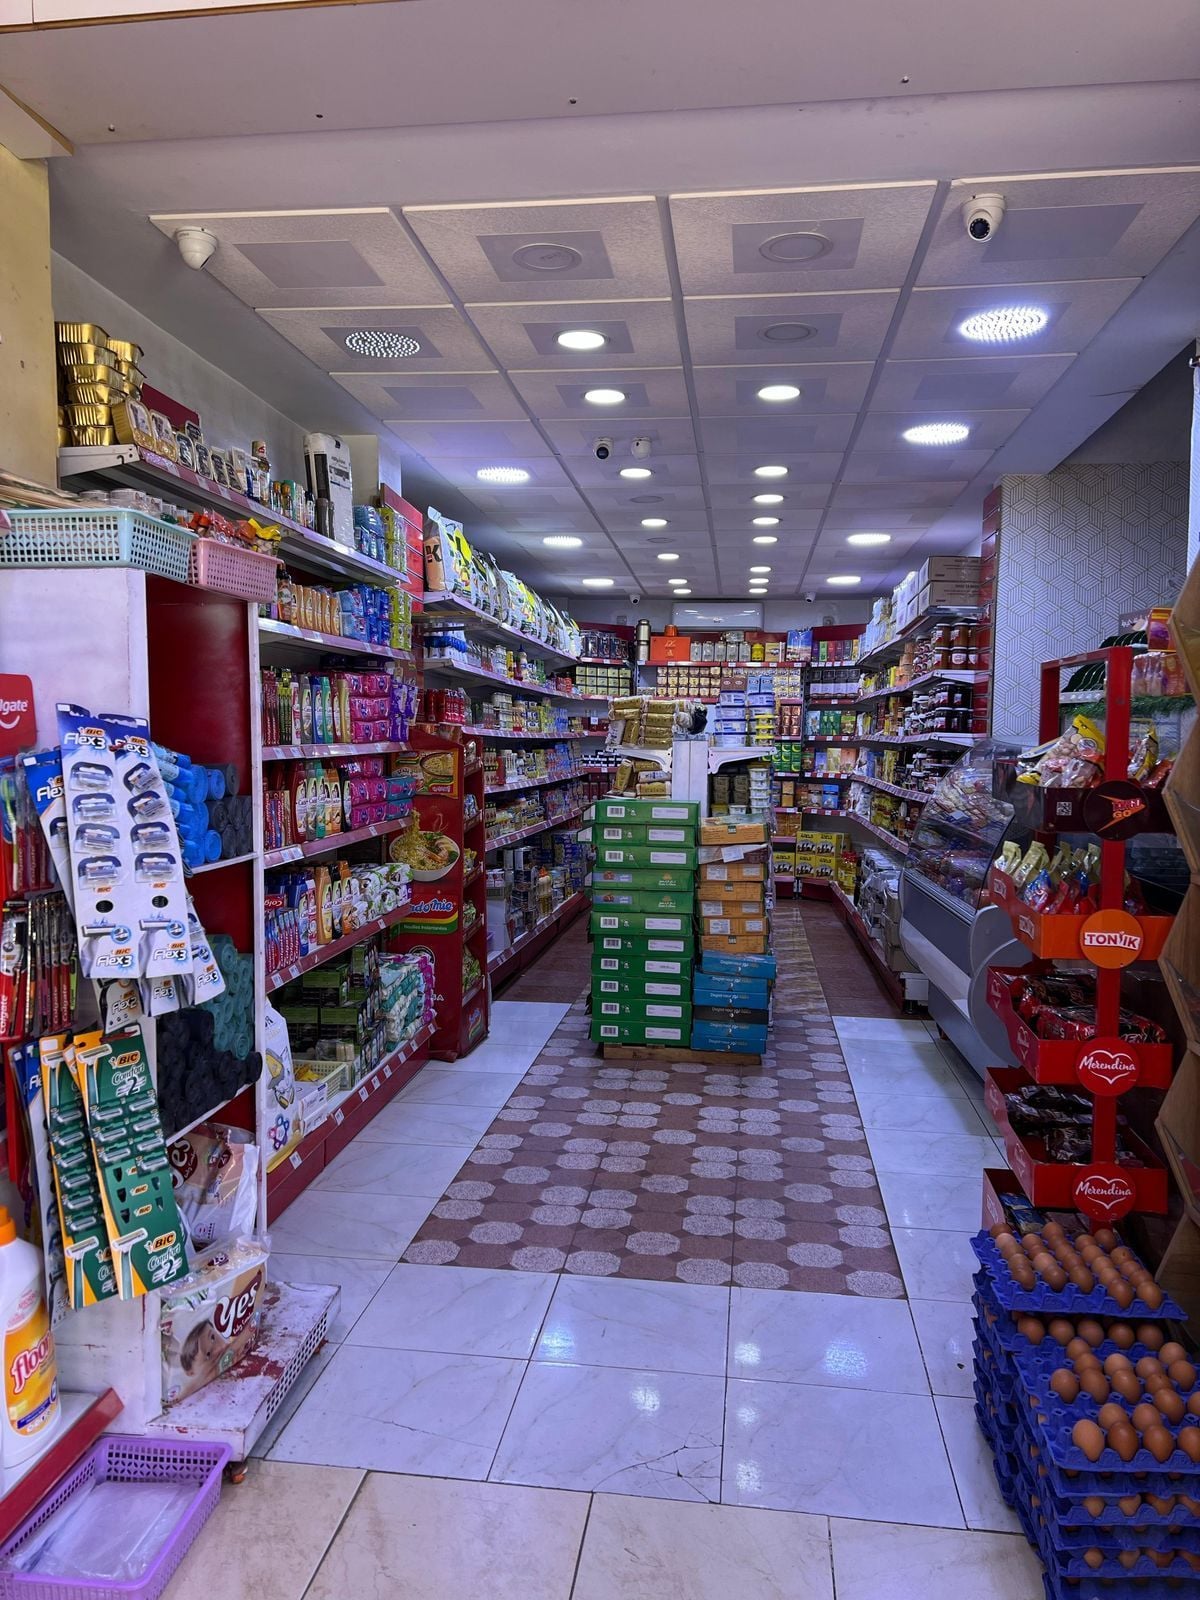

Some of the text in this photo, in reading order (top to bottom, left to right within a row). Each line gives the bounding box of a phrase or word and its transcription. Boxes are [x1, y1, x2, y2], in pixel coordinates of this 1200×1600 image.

[64, 733, 105, 749] Flex3
[37, 786, 63, 801] Flex
[265, 900, 283, 908] Colg
[1086, 933, 1138, 948] TONIK
[96, 955, 132, 968] Flex3
[154, 949, 187, 961] Flex3
[118, 1053, 138, 1065] BIC
[1079, 1055, 1136, 1071] Merendina
[112, 1063, 145, 1085] Comfort
[135, 1185, 147, 1194] BIC
[1075, 1180, 1132, 1196] Merendina
[154, 1234, 174, 1249] BIC
[147, 1243, 181, 1271] Comfort
[216, 1282, 258, 1339] yes
